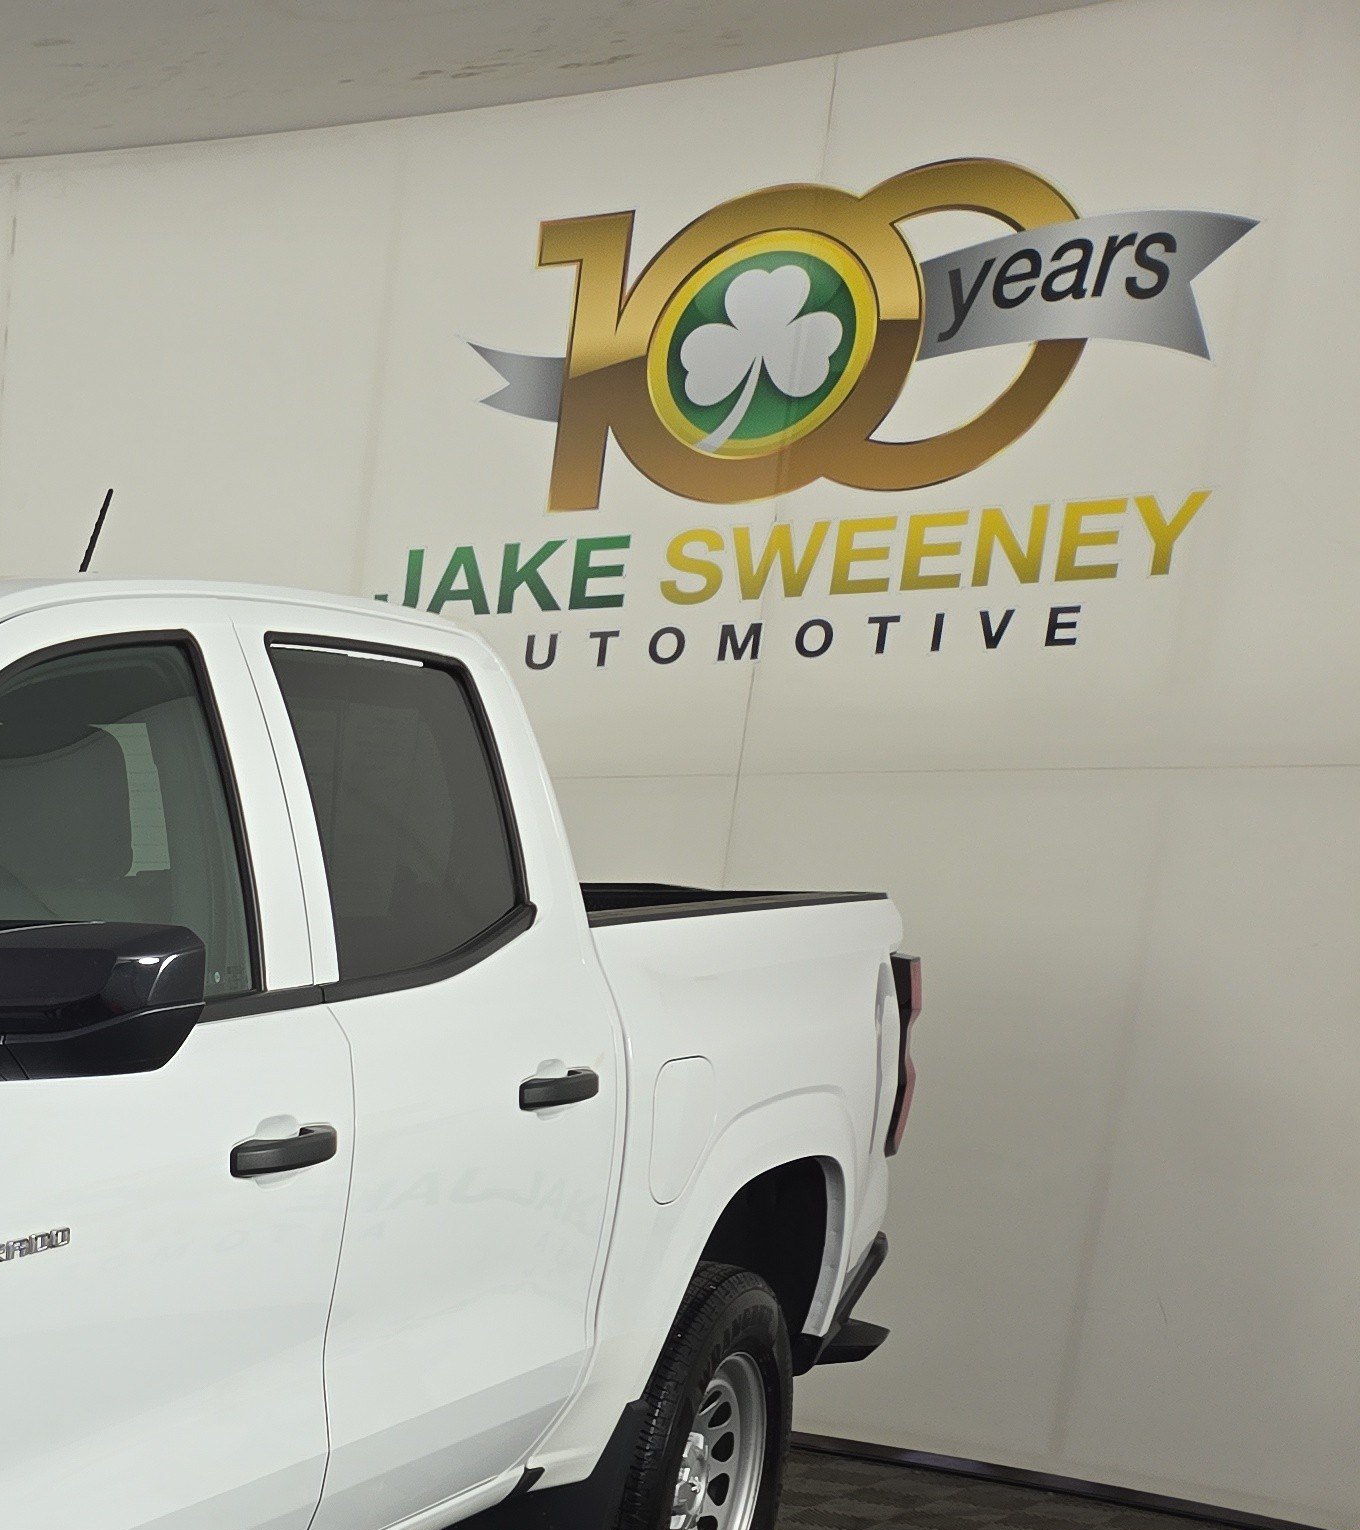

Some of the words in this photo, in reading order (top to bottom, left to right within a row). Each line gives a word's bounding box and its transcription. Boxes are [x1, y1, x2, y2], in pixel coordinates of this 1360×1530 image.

[536, 157, 1084, 514] 100
[937, 229, 1178, 345] years
[374, 534, 633, 616] JAKE
[660, 490, 1213, 606] SWEENEY
[524, 604, 1083, 671] UTOMOTIVE
